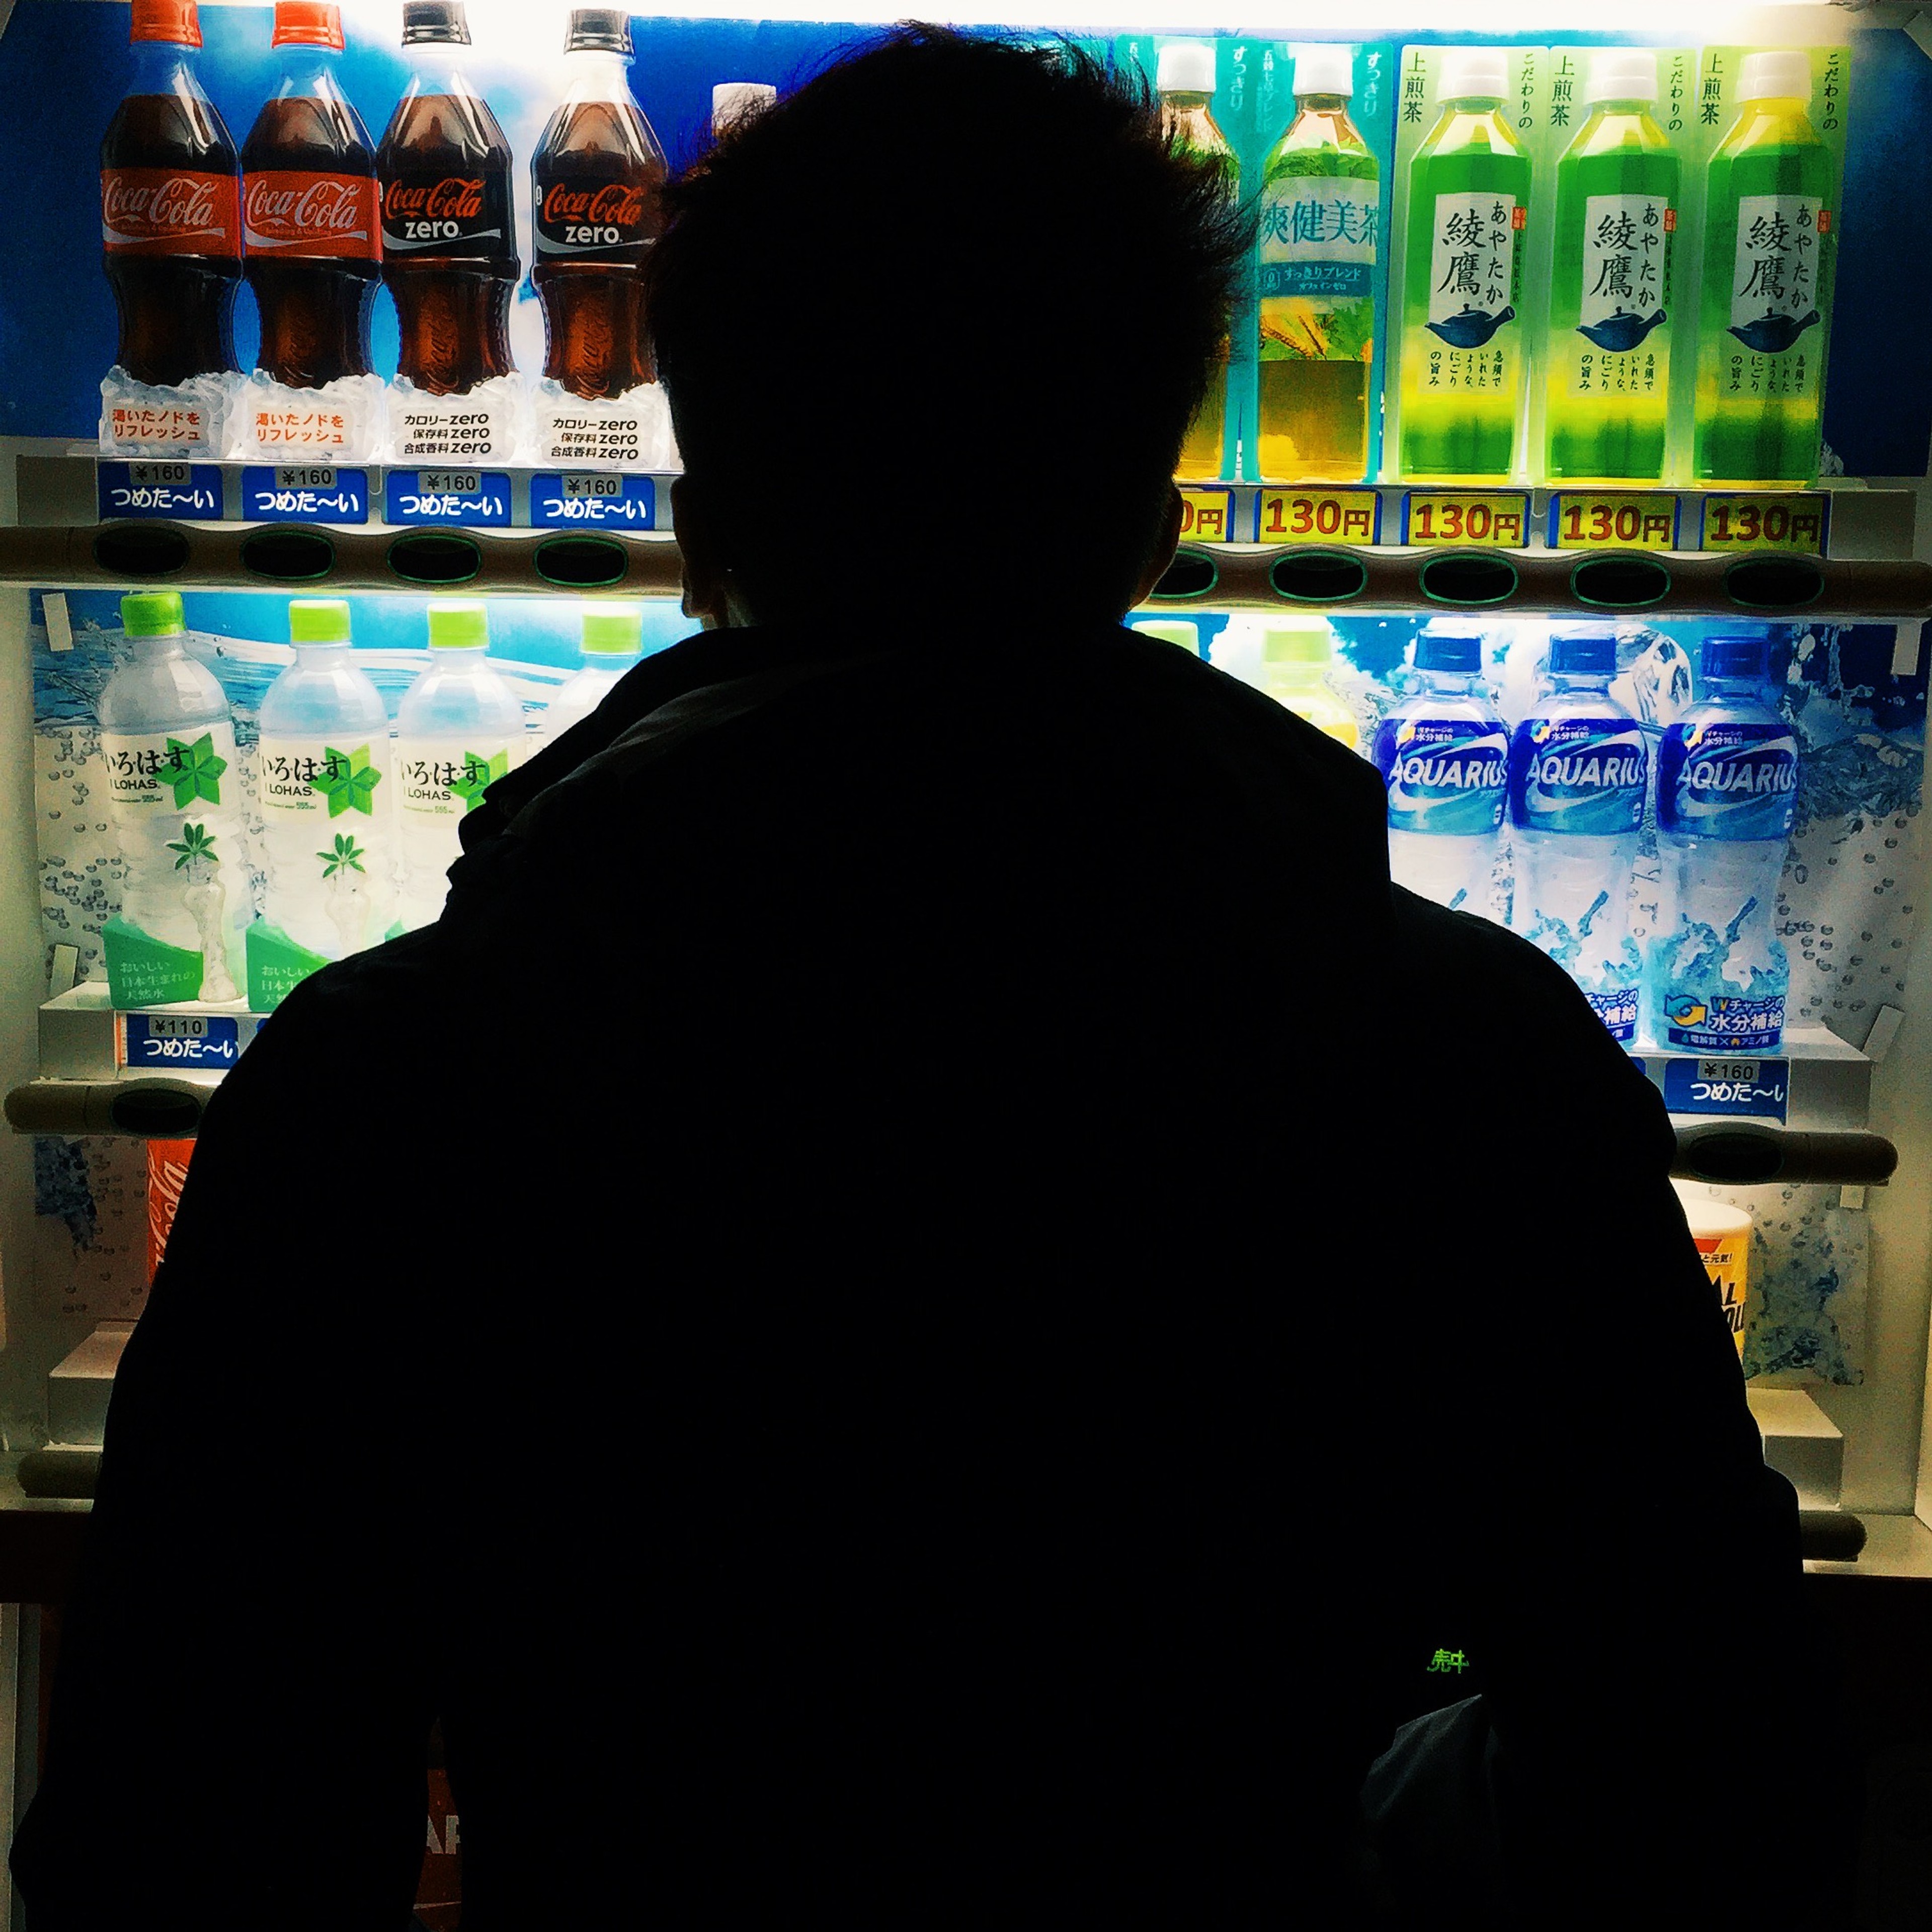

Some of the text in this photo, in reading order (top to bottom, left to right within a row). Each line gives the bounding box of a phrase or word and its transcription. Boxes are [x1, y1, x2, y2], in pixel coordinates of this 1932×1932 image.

[1403, 52, 1427, 123] 上煎茶
[1518, 53, 1535, 129] こだわりの
[1550, 55, 1575, 127] 上煎茶
[1668, 56, 1683, 132] こだわりの
[1700, 53, 1723, 125] 上煎茶
[1822, 53, 1839, 131] こだわりの
[104, 176, 217, 226] Coca-Cola
[247, 179, 362, 229] Coca-Cola
[385, 178, 486, 219] Coca-Cola
[544, 184, 645, 225] Coca-Cola
[406, 220, 459, 239] zero
[565, 225, 619, 244] zero
[1263, 198, 1378, 247] 爽健美茶
[1437, 208, 1487, 296] 綾鷹
[1486, 201, 1507, 305] あやたか
[1589, 210, 1639, 298] 綾鷹
[1638, 203, 1659, 307] あやたか
[1739, 211, 1792, 300] 綾鷹
[1791, 204, 1813, 308] あやたか
[1428, 351, 1442, 386] の旨み
[1450, 352, 1462, 388] にごり
[1478, 353, 1489, 387] いれた
[1579, 354, 1593, 390] の旨み
[1600, 355, 1613, 391] にごり
[1629, 355, 1640, 390] いれた
[1751, 355, 1763, 392] にごり
[112, 409, 201, 426] 渇いたノドを
[114, 425, 201, 441] リフレッシュ
[256, 413, 344, 428] 渇いたノドを
[257, 429, 344, 444] リフレッシュ
[135, 465, 185, 481] ¥160
[282, 469, 332, 485] ¥160
[427, 475, 476, 492] ¥160
[568, 479, 617, 496] ¥160
[1265, 498, 1371, 537] 130円
[1414, 503, 1520, 540] 130円
[1563, 505, 1671, 543] 130円
[1711, 505, 1818, 543] 130円
[114, 779, 158, 790] LOHAS
[1525, 752, 1645, 787] AQUARIUS
[1676, 759, 1798, 793] AQUARIUS
[269, 783, 313, 796] LOHAS
[408, 787, 452, 800] LOHAS
[119, 961, 171, 973] おいしい
[121, 971, 196, 988] 日本生まれの
[262, 965, 310, 977] おいしい
[126, 988, 166, 1000] 天然水
[1713, 997, 1785, 1012] Wチャージの
[155, 1019, 202, 1034] ¥110
[1711, 1010, 1784, 1032] 水分補給
[1704, 1062, 1753, 1079] ¥160
